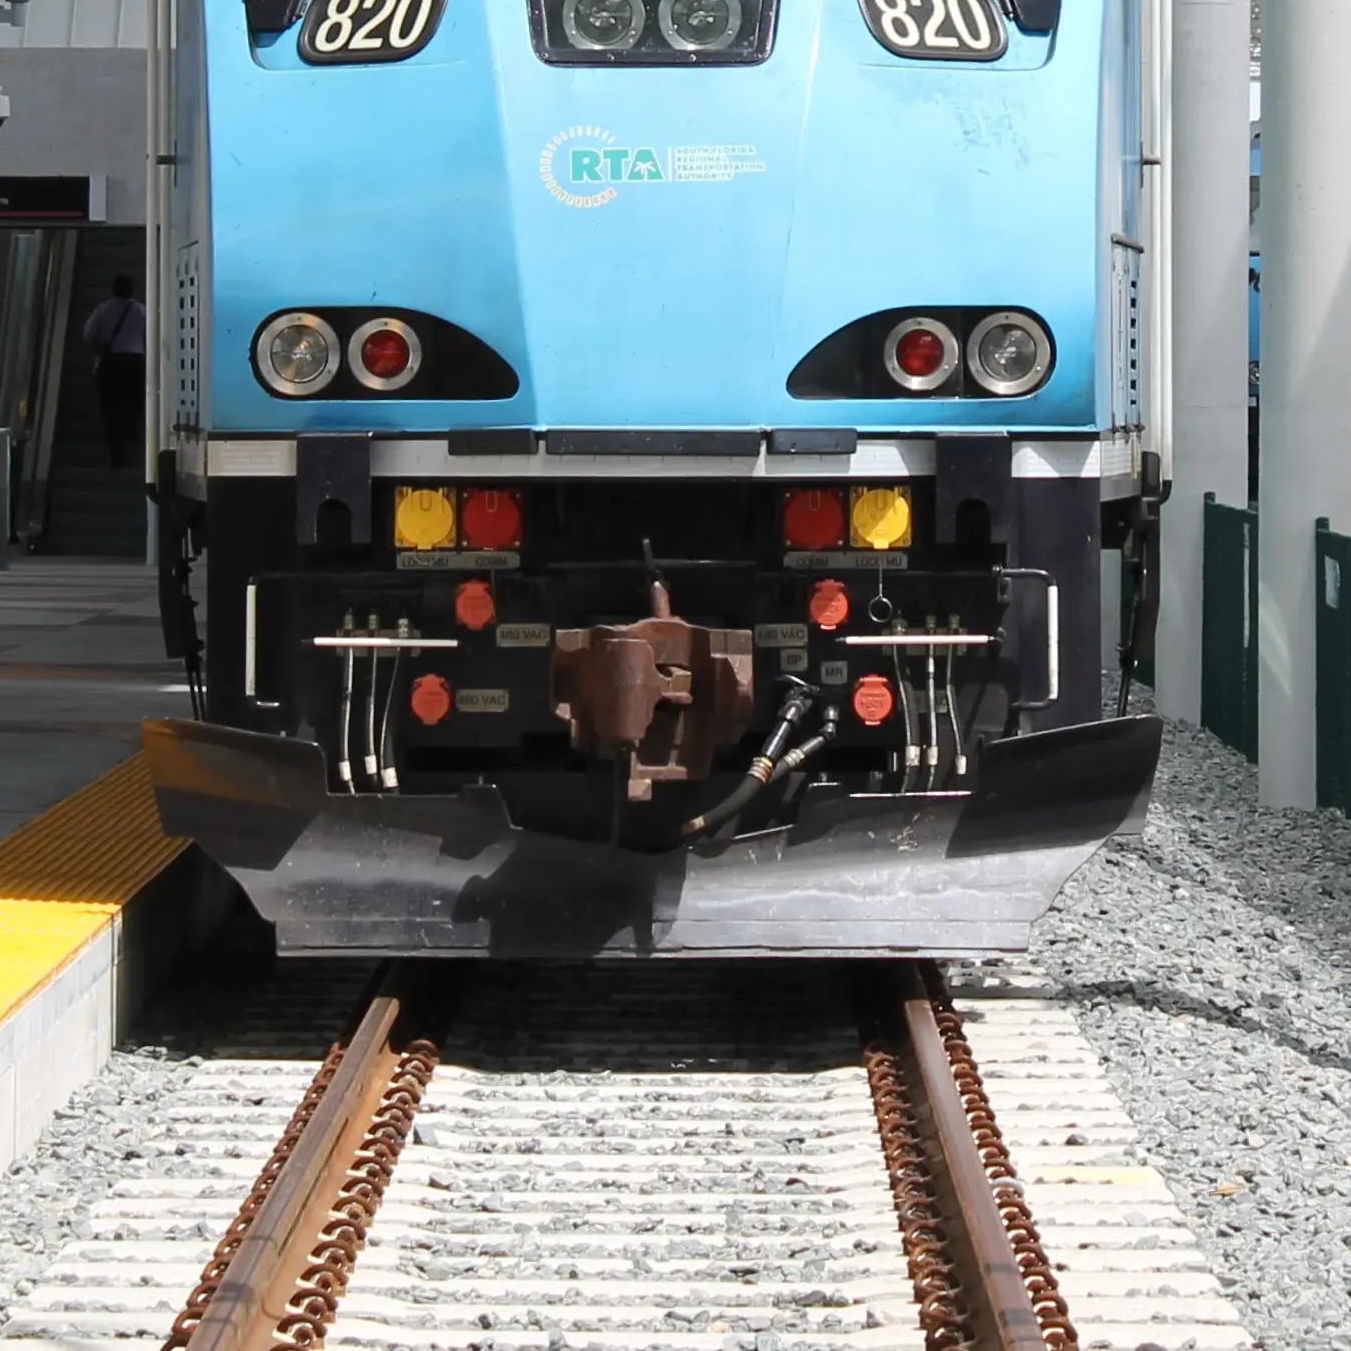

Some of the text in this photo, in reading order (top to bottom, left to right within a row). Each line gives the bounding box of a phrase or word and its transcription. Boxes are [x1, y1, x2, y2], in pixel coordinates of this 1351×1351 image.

[571, 149, 663, 181] RTA
[522, 629, 547, 640] VAC
[758, 629, 805, 640] 480 VAC
[825, 667, 843, 677] MR
[481, 694, 506, 705] VAC
